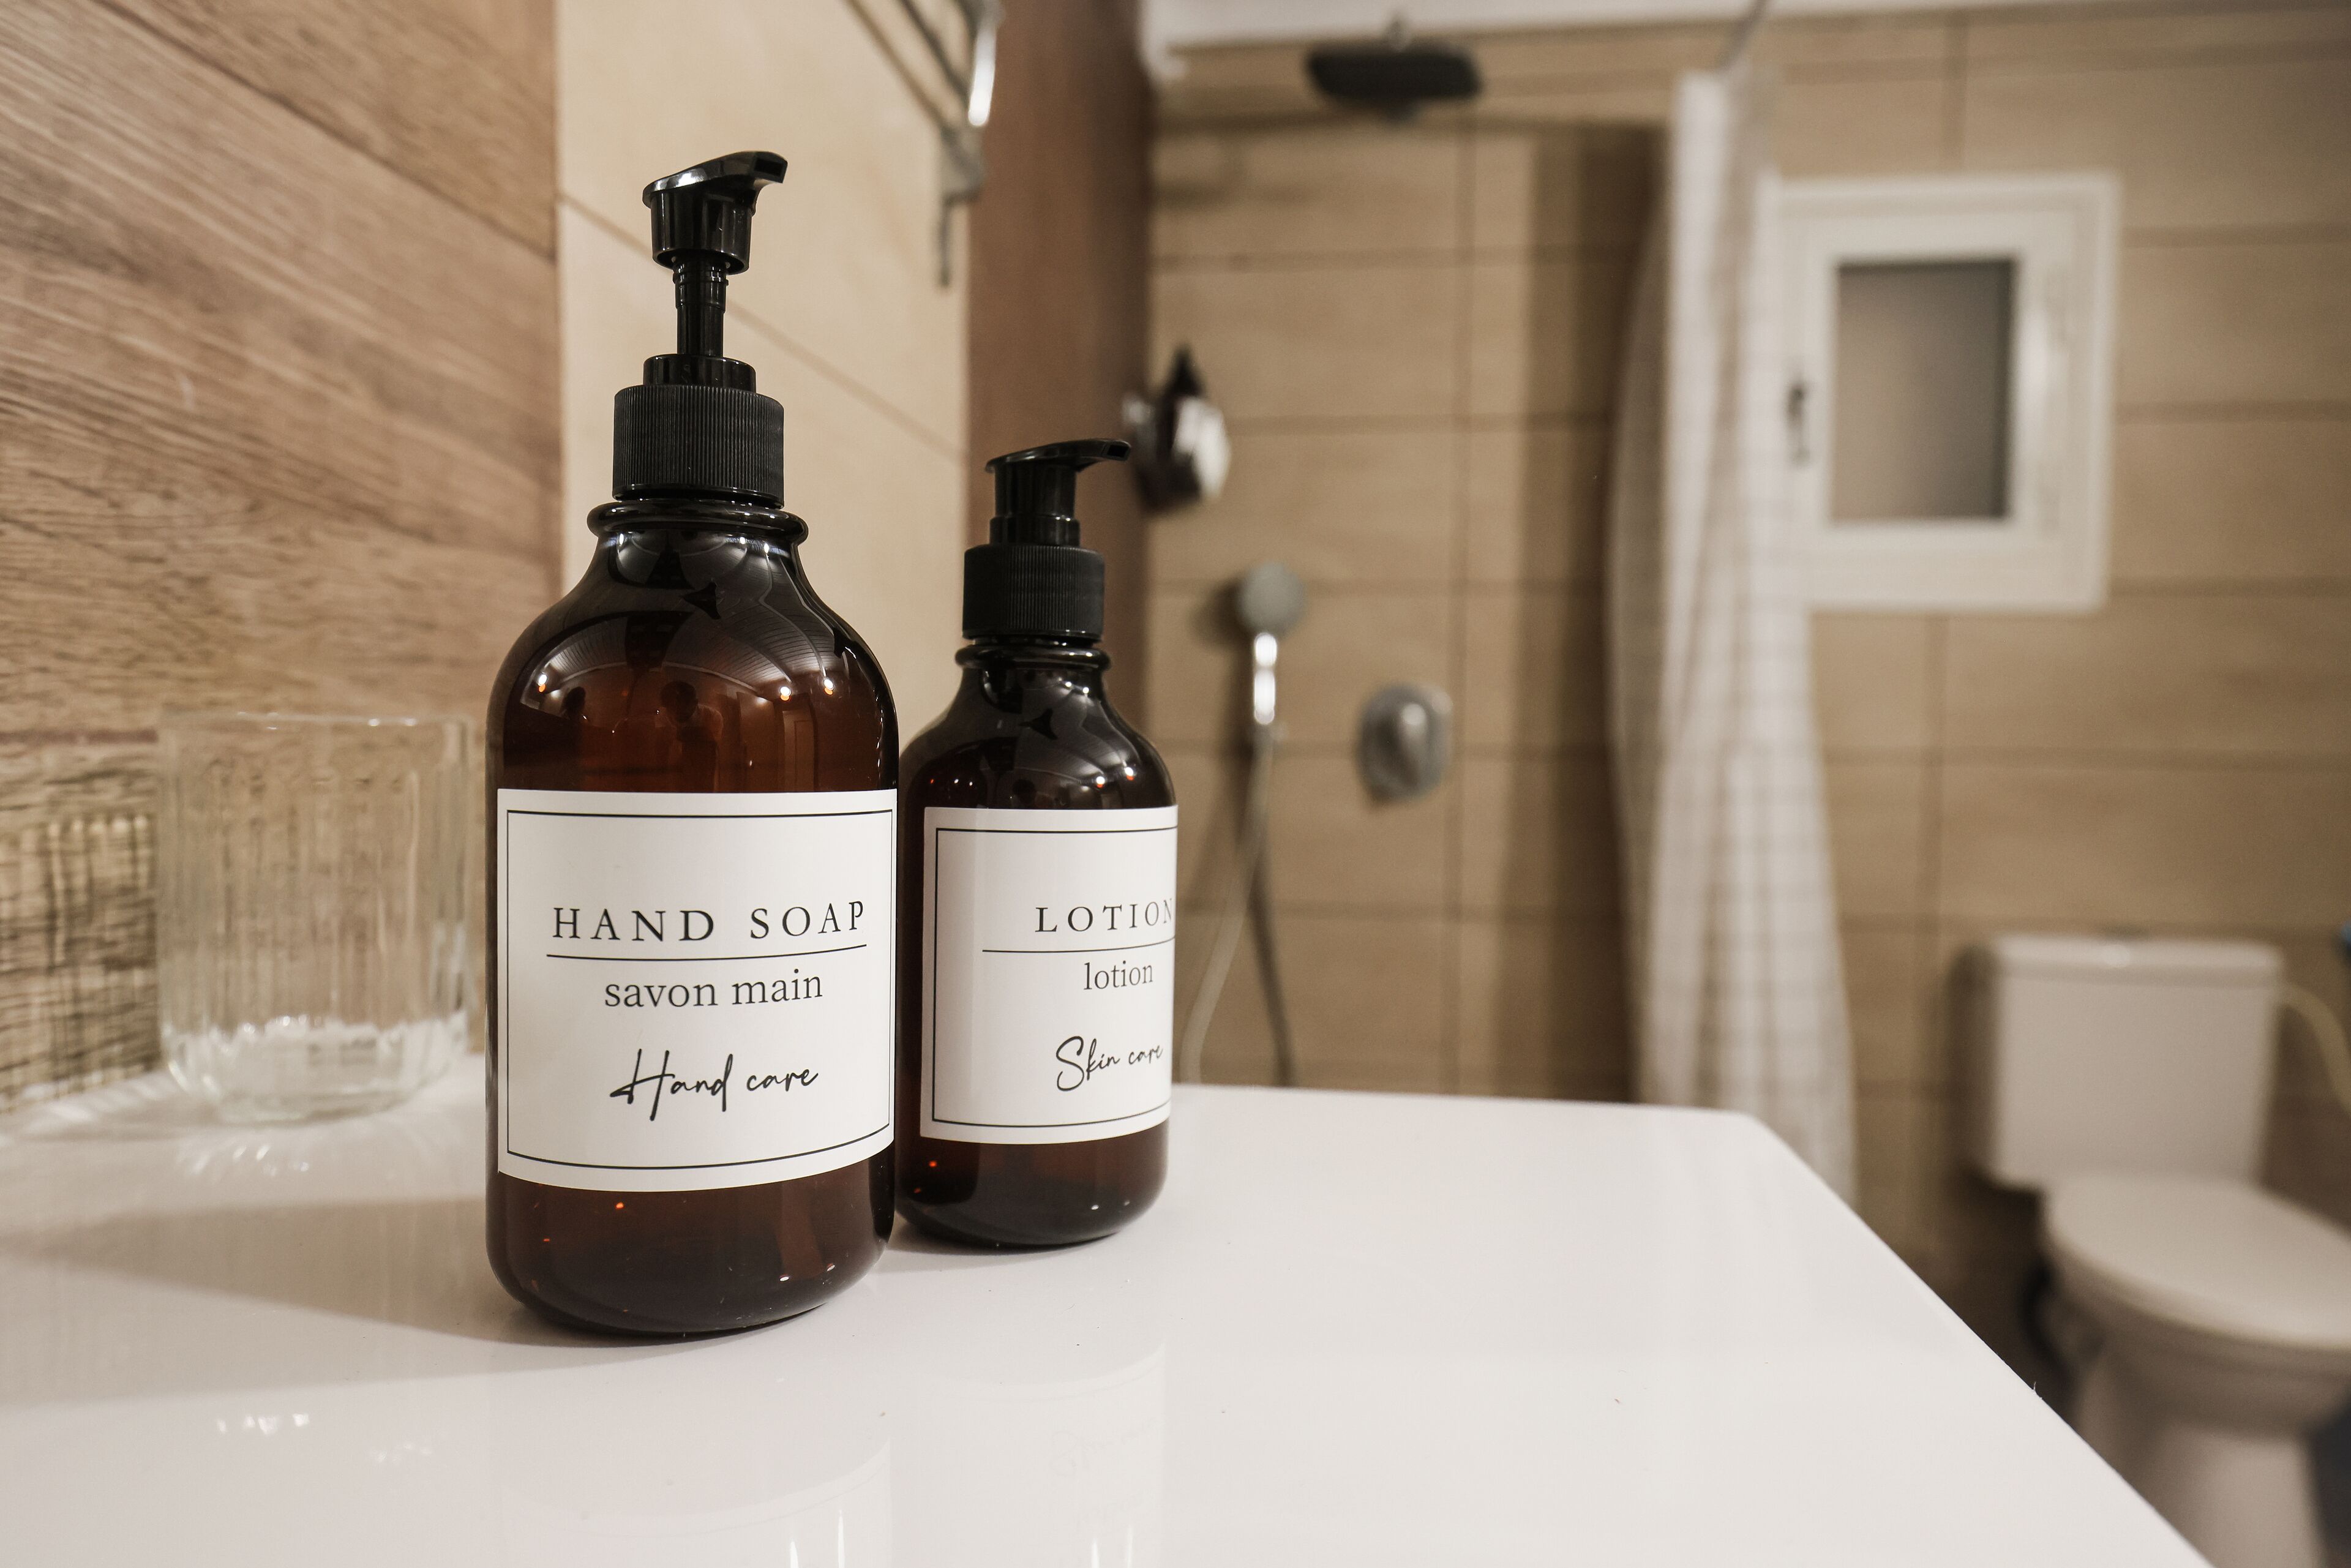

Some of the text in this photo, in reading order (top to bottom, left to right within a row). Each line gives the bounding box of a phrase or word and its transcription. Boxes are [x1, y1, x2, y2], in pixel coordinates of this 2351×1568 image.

[552, 901, 864, 942] HAND SOAP
[1035, 898, 1174, 932] LOTION
[604, 968, 823, 1008] savon main
[1083, 959, 1153, 991] lotion
[1056, 1035, 1164, 1092] Skin care
[609, 1048, 819, 1122] Hand care
